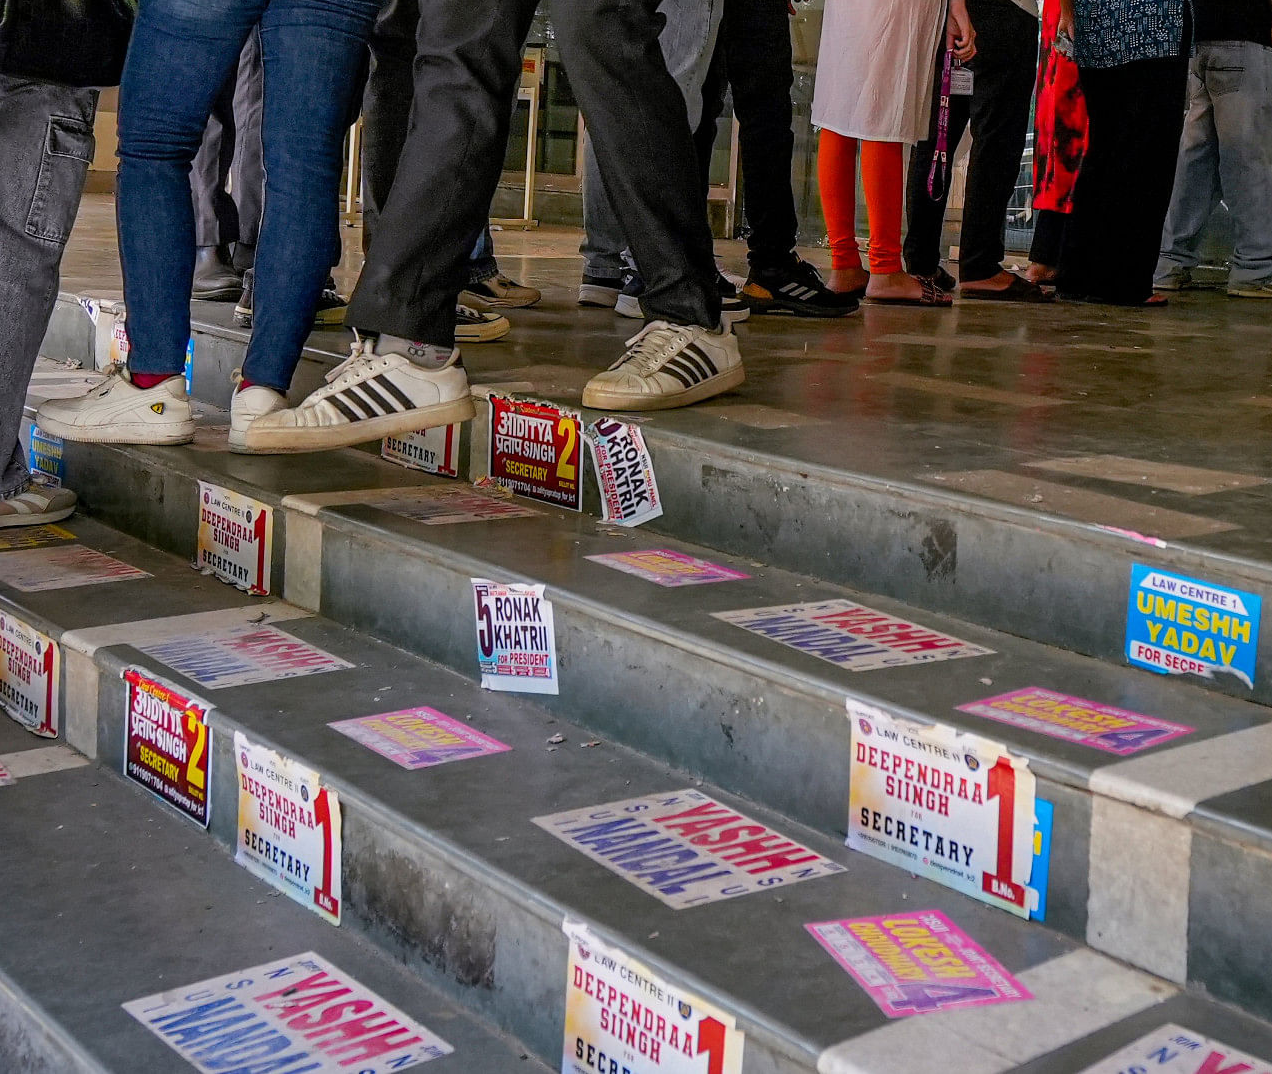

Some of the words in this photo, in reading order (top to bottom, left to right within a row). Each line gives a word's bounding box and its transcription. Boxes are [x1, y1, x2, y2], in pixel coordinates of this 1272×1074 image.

[32, 438, 63, 459] UMESHH
[35, 455, 60, 474] YADAV
[386, 436, 436, 466] SECRETARY
[506, 459, 548, 482] SECRETARY
[523, 440, 556, 464] SINGH
[556, 417, 576, 480] 2
[620, 434, 649, 508] RONAK
[604, 462, 624, 520] PRESIDENT
[607, 435, 637, 519] KHATRII
[201, 508, 253, 544] DEEPENDRAA
[211, 497, 221, 508] LAW
[222, 501, 241, 517] CENTRE
[213, 528, 240, 553] SIINGH
[250, 509, 269, 596] 1
[202, 549, 249, 583] SECRETARY
[495, 597, 542, 622] RONAK
[1152, 576, 1177, 592] LAW
[1180, 584, 1228, 606] CENTRE
[1231, 598, 1237, 609] 1
[475, 585, 493, 658] 5
[494, 624, 548, 651] KHATRII
[734, 615, 889, 663] NANDAL
[811, 608, 966, 654] YASHH
[1137, 591, 1251, 644] UMESHH
[498, 654, 507, 664] FOR
[509, 652, 549, 666] PRESIDENT
[1138, 645, 1161, 665] FOR
[1146, 619, 1237, 666] YADAV
[8, 657, 31, 686] SIINGH
[38, 642, 57, 737] 1
[0, 679, 39, 719] SECRETARY
[140, 745, 179, 783] SECRETARY
[156, 727, 186, 763] SINGH
[185, 709, 206, 790] 2
[876, 726, 899, 743] LAW
[903, 735, 950, 760] CENTRE
[250, 759, 265, 775] LAW
[266, 766, 294, 792] CENTRE
[856, 742, 985, 805] DEEPENDRAA
[885, 775, 950, 817] SIINGH
[241, 772, 315, 831] DEEPENDRAA
[259, 803, 297, 840] SIINGH
[554, 797, 679, 827] NSUI
[244, 828, 310, 883] SECRETARY
[313, 787, 339, 918] 1
[652, 802, 821, 876] YASHH
[860, 806, 974, 868] SECRETARY
[982, 755, 1026, 910] 1
[561, 817, 733, 896] NANDAL
[683, 867, 822, 905] NSUI
[142, 965, 295, 1015] NSUI
[594, 952, 617, 973] LAW
[620, 965, 664, 1003] CENTRE
[253, 971, 424, 1068] YASHH
[573, 964, 694, 1059] DEEPENDRAA
[600, 1007, 662, 1066] SIINGH
[697, 1015, 726, 1074] 1
